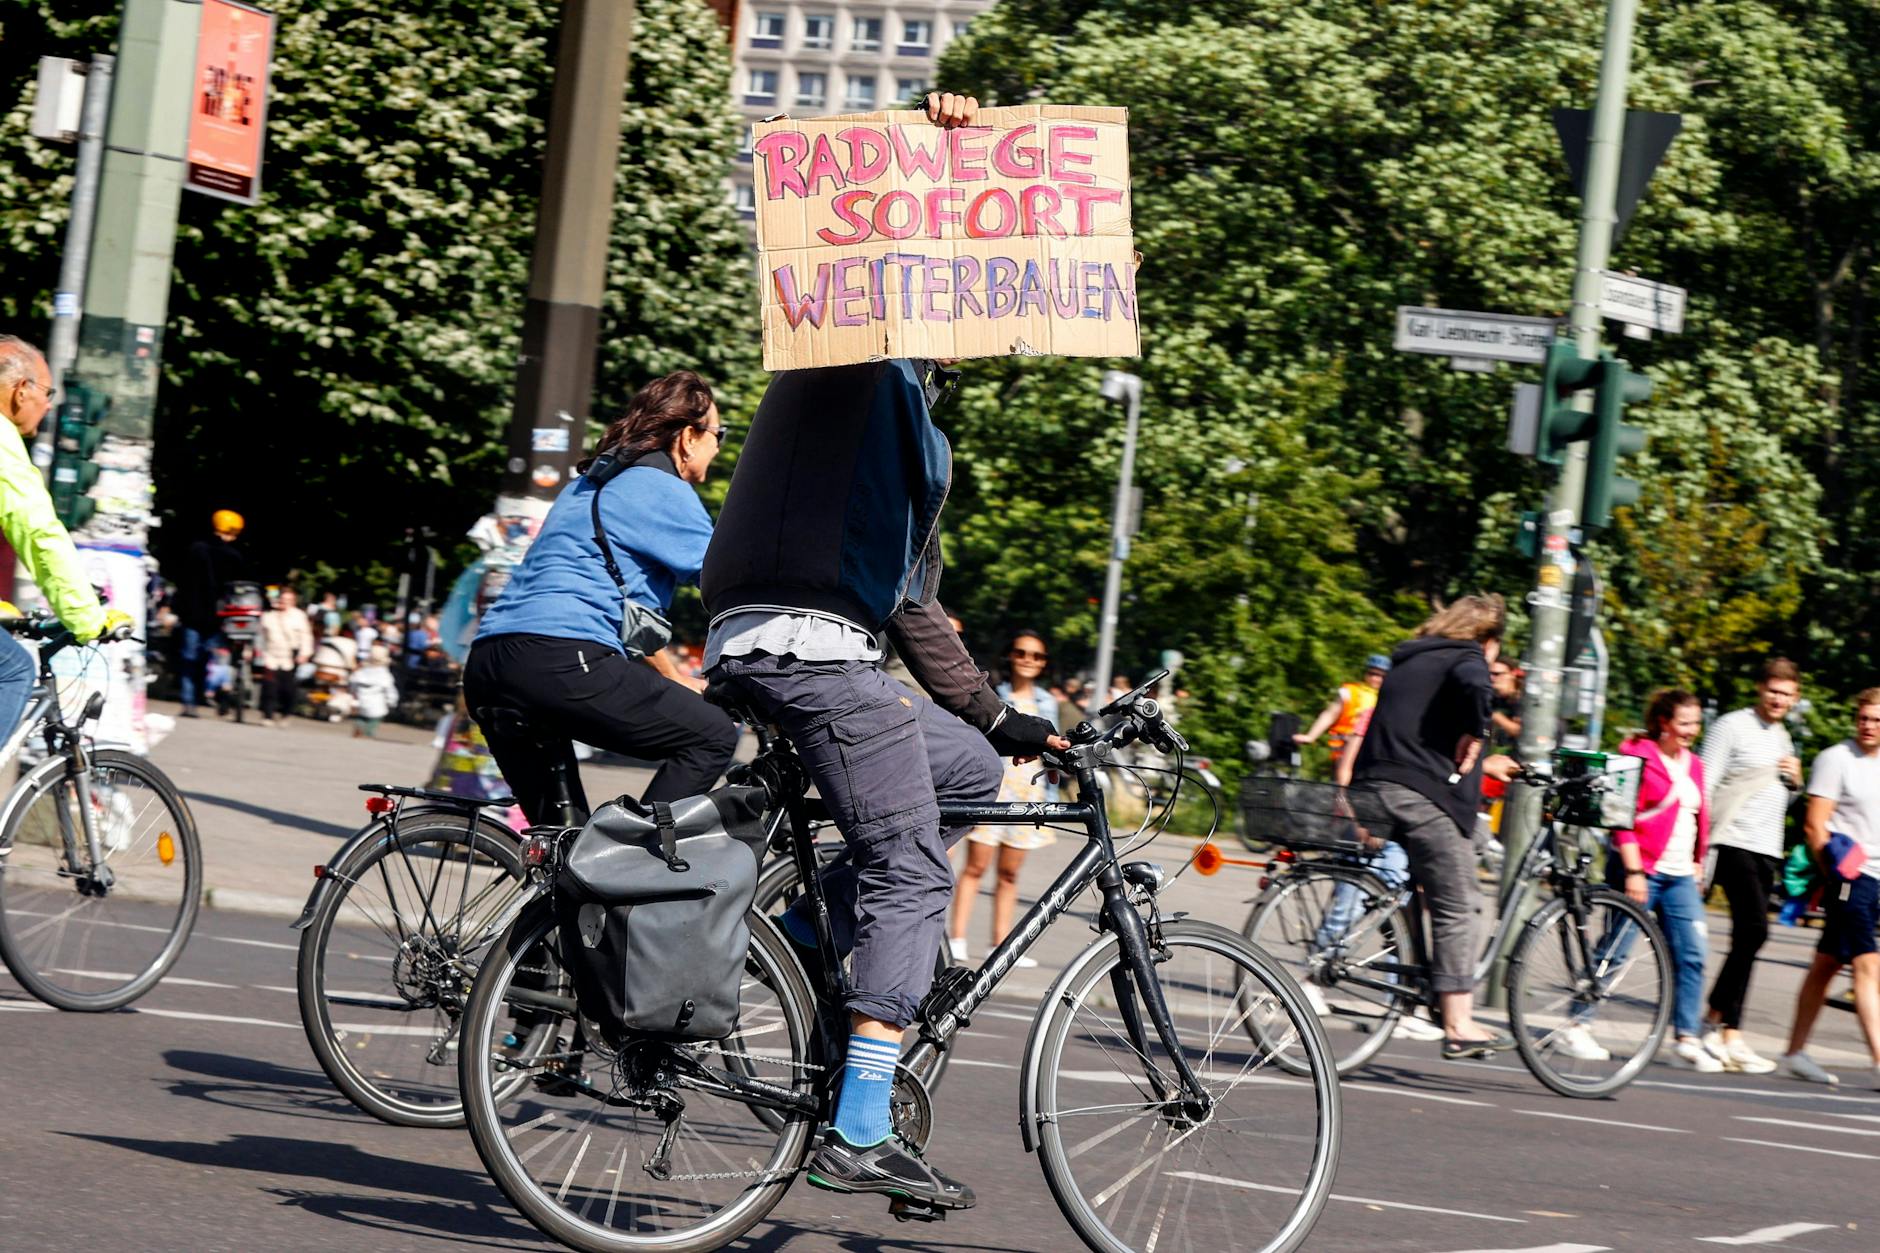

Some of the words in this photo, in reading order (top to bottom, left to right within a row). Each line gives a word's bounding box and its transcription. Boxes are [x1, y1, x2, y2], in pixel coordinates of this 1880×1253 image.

[755, 123, 1099, 200] RADWEGE
[816, 182, 1124, 245] SOFORT
[772, 252, 1136, 332] WEITERBAUEN
